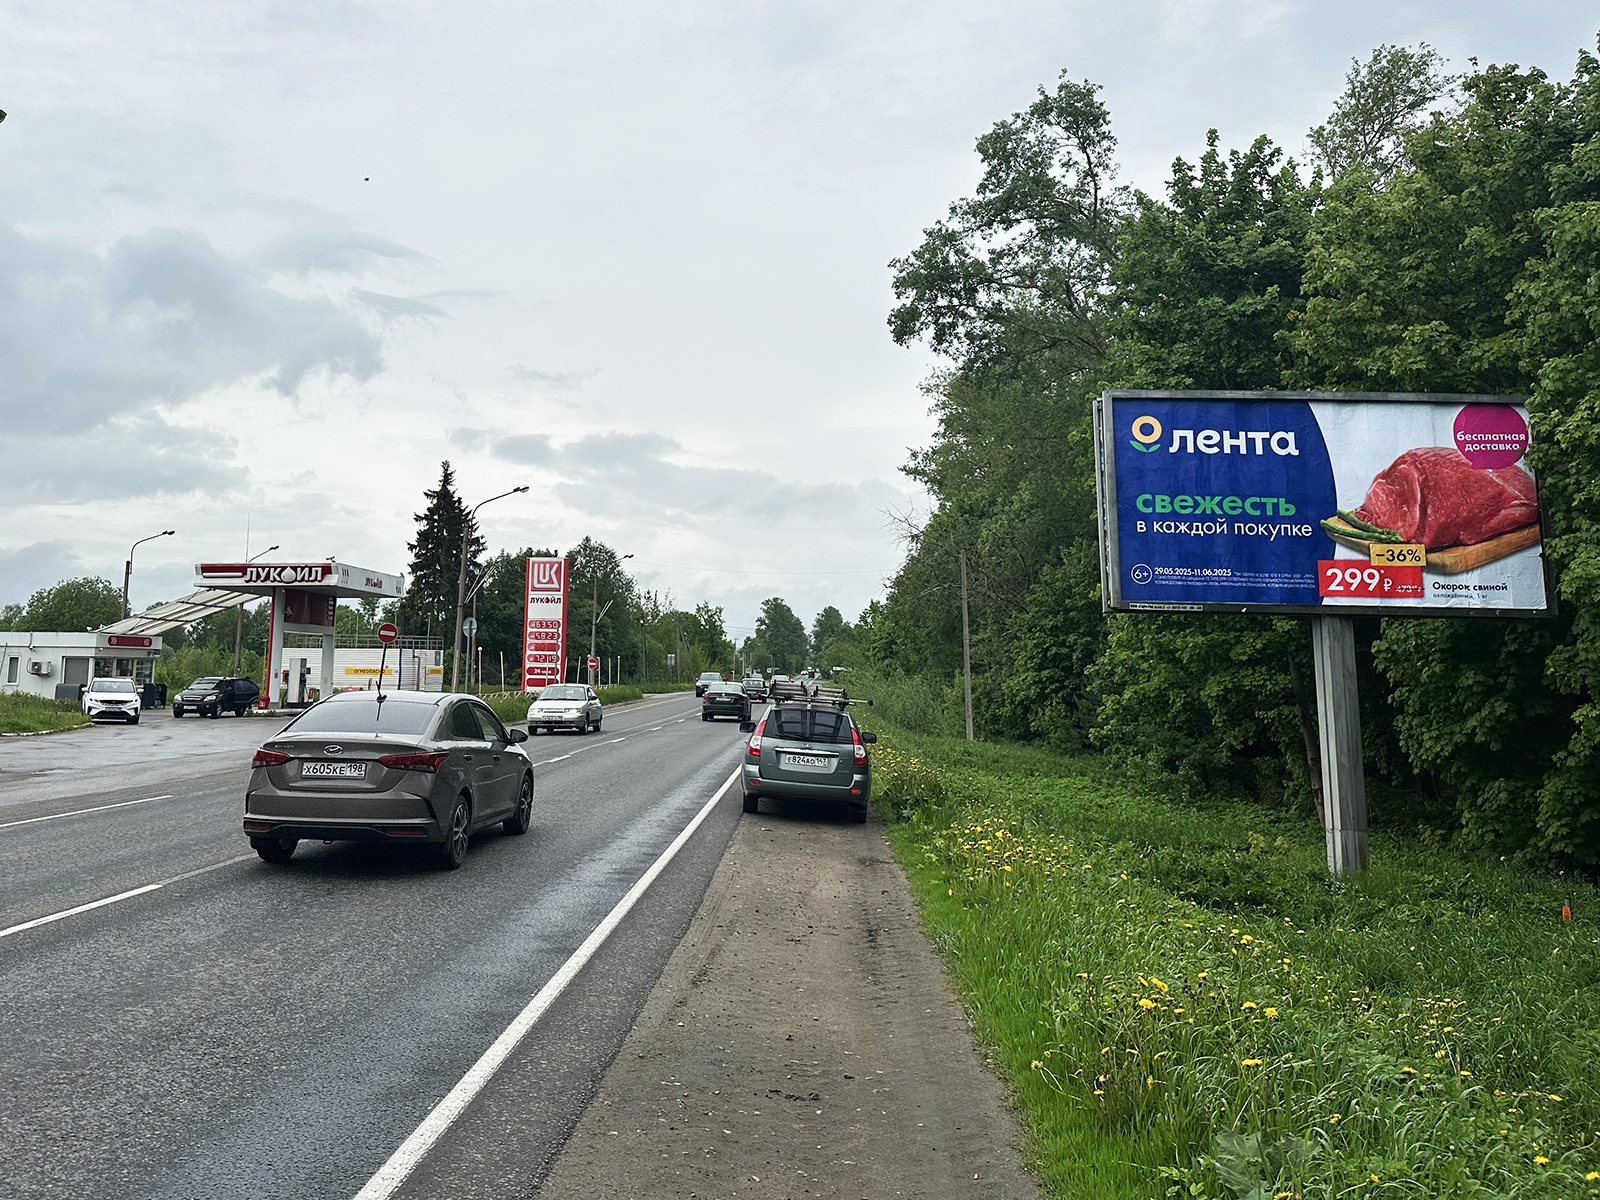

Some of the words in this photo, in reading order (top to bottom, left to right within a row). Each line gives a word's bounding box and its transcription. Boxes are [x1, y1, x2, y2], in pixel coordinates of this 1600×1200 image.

[1456, 430, 1526, 441] бесплатная
[1169, 428, 1299, 456] лента
[1135, 493, 1296, 516] свежесть
[1136, 520, 1147, 532] в
[1153, 517, 1228, 537] каждой
[1234, 522, 1313, 541] покупке
[1134, 568, 1149, 579] 6+
[1154, 567, 1232, 577] 29.05.2025-11.06.2025
[1432, 581, 1471, 592] Окорок
[1473, 582, 1508, 591] свиной
[530, 596, 562, 604] ЛУКОЙЛ
[787, 755, 815, 765] Е824АО
[305, 763, 345, 775] Х605КЕ
[347, 764, 363, 773] 198
